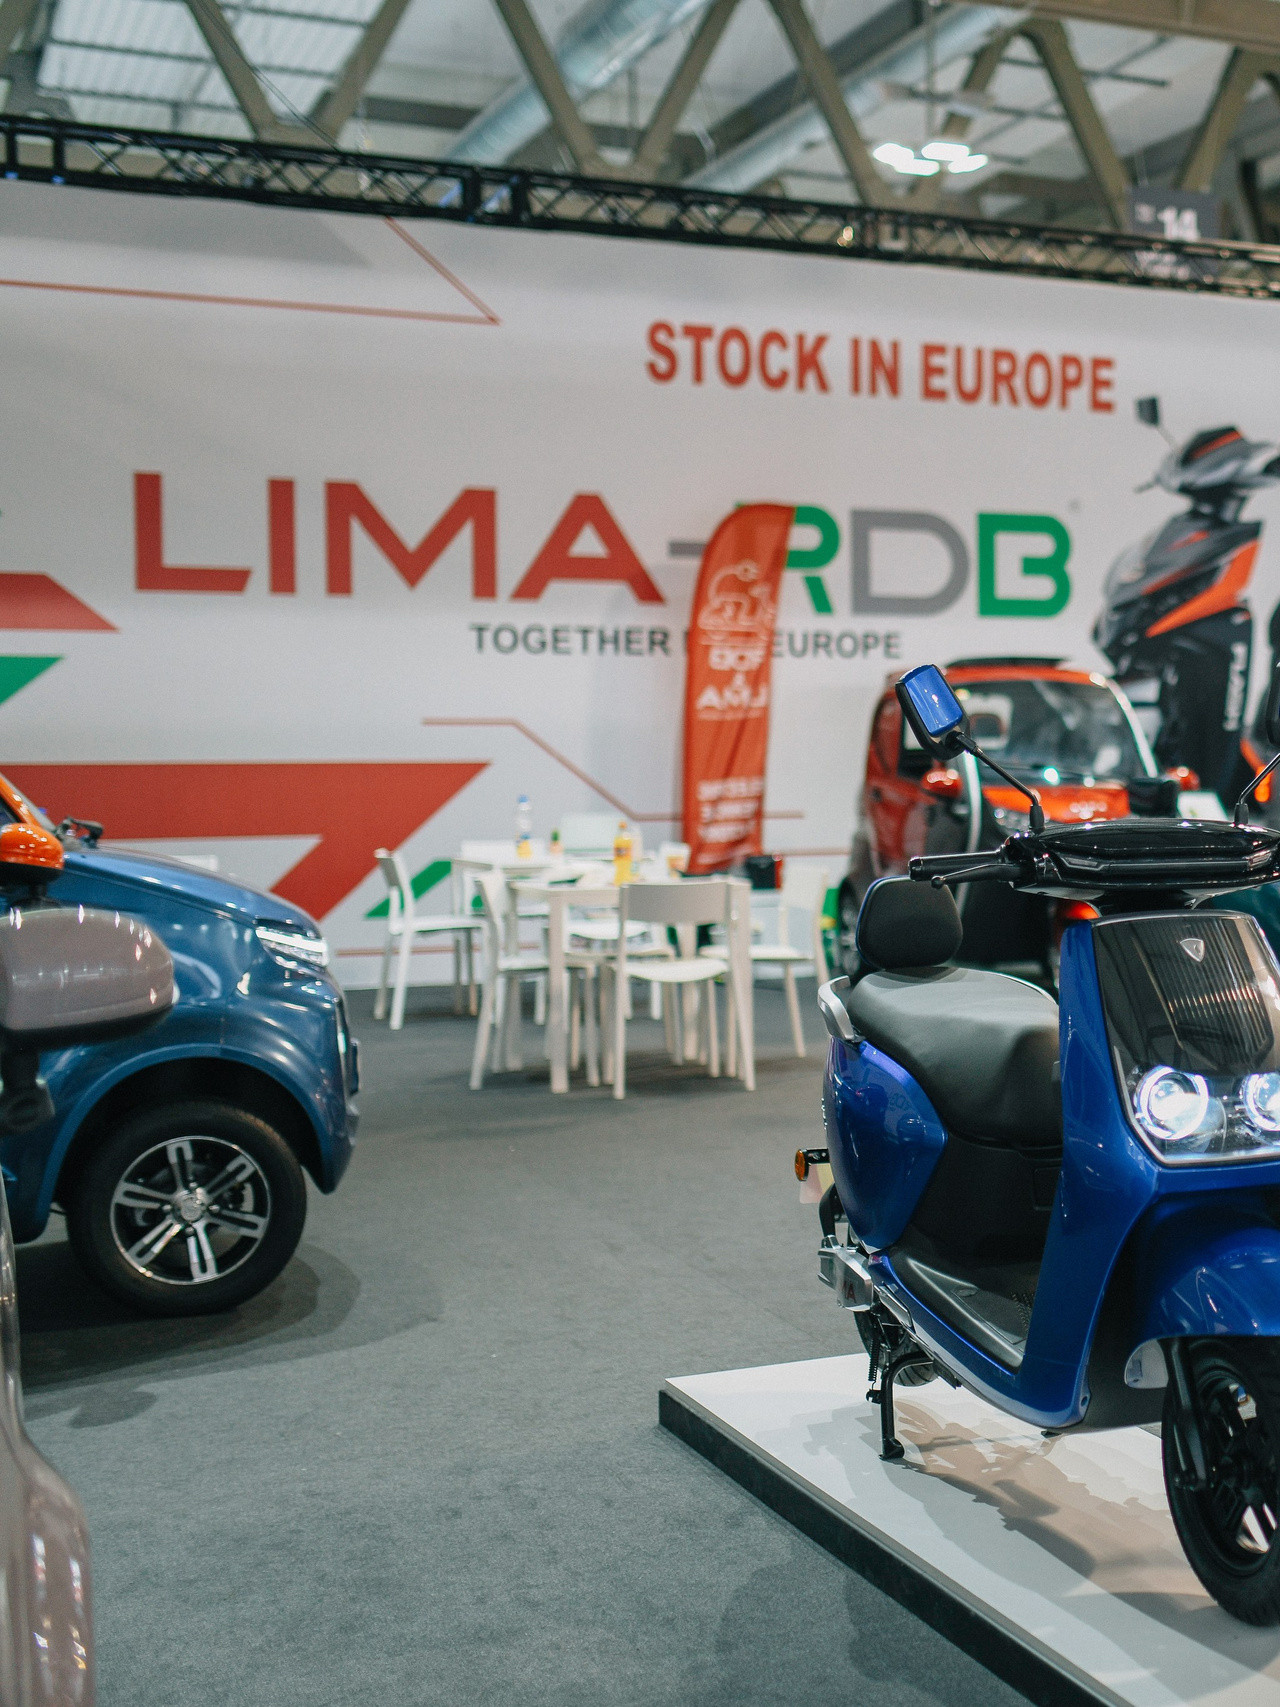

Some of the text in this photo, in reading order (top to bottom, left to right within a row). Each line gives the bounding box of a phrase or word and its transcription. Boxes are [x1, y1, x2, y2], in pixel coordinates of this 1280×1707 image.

[646, 320, 1117, 412] STOCK IN EUROPE
[469, 623, 671, 657] TOGETHER
